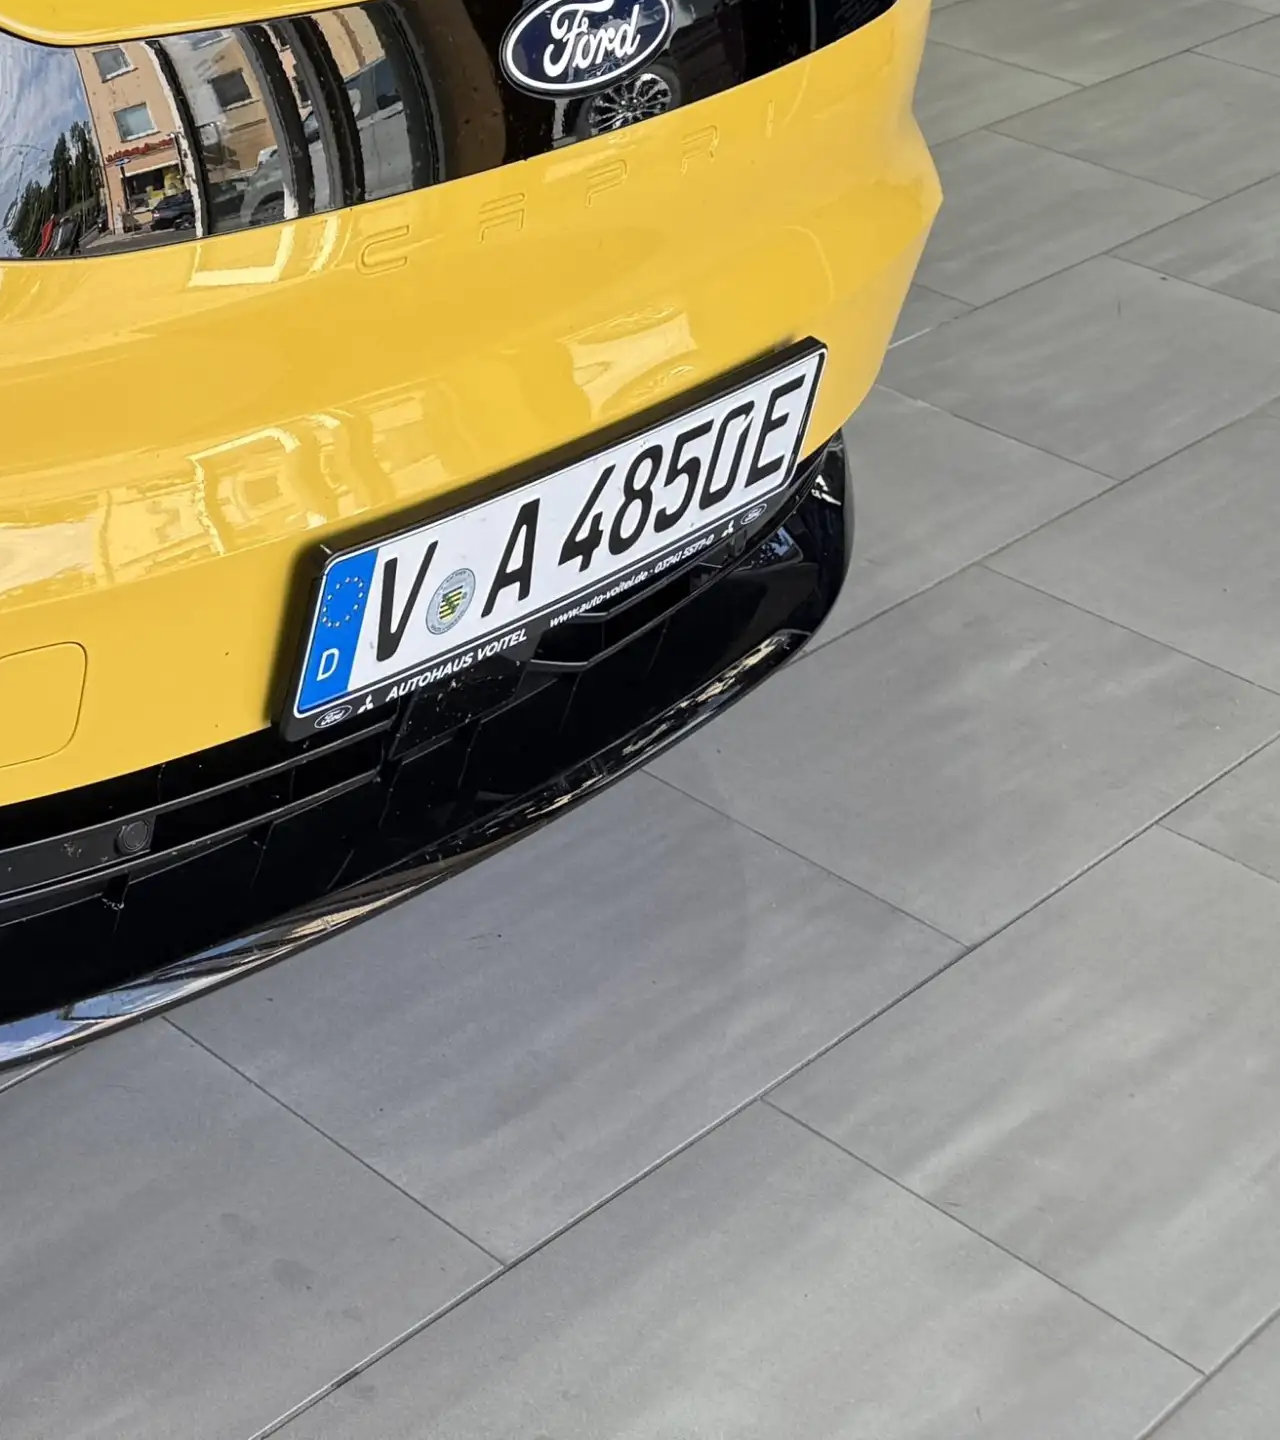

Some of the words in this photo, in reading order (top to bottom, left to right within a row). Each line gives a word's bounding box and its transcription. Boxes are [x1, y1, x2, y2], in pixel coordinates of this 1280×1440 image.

[355, 100, 775, 276] CAPRI
[376, 540, 438, 662] V
[481, 497, 541, 618] A
[558, 373, 806, 573] 4850E
[549, 570, 648, 628] www.auto-voitel.de
[316, 647, 340, 681] D
[385, 652, 474, 702] AUTOHAUS
[477, 628, 527, 662] VOITEL
